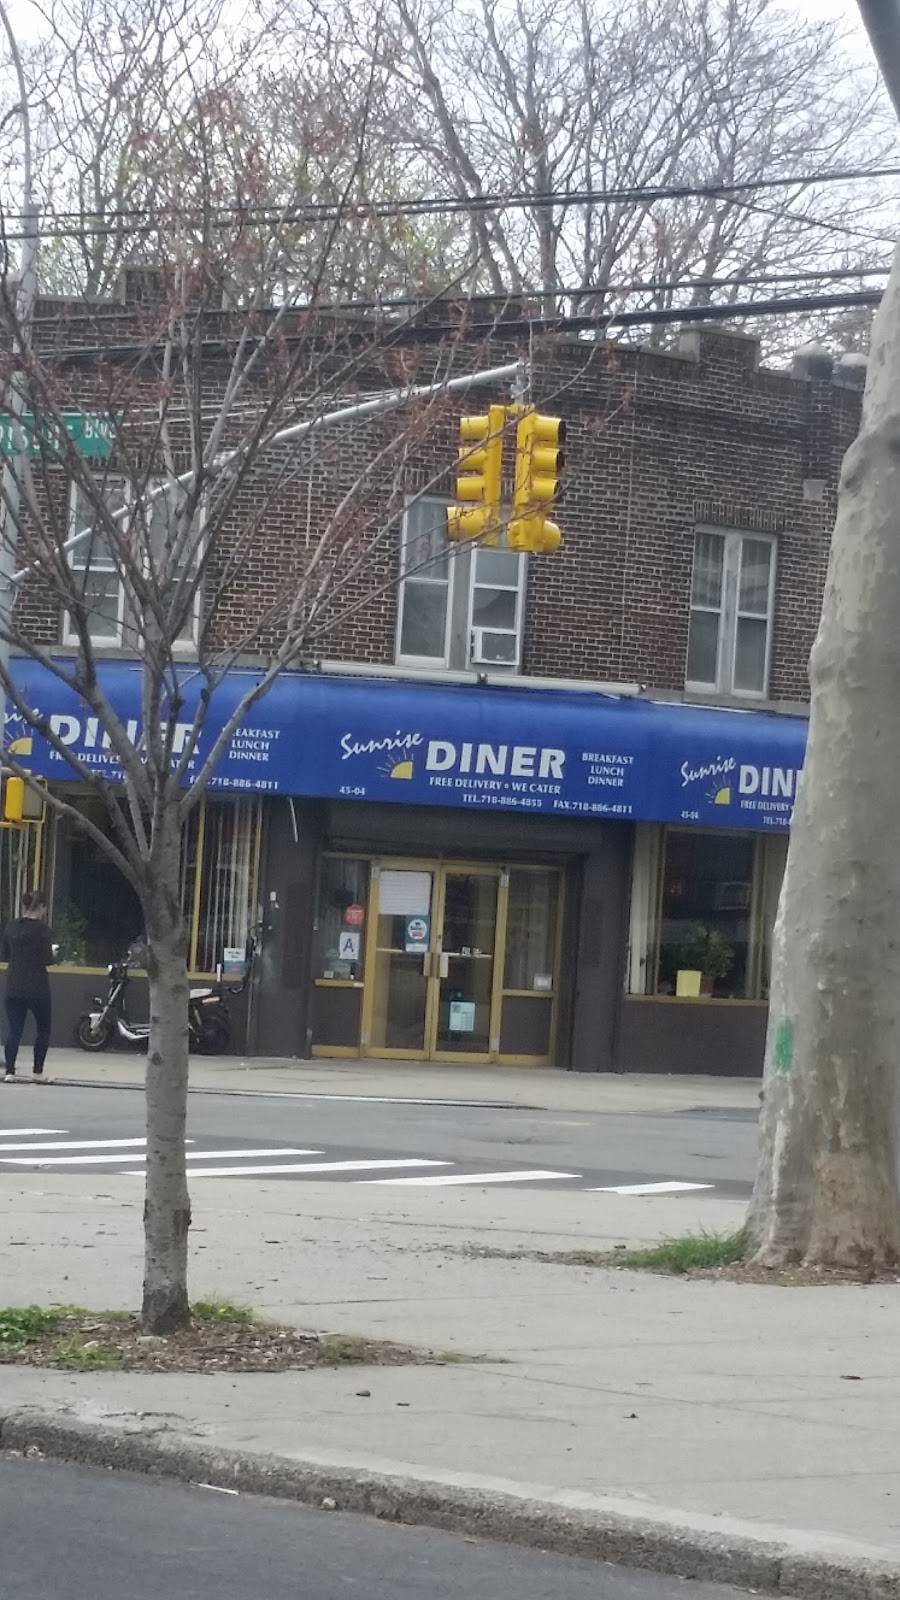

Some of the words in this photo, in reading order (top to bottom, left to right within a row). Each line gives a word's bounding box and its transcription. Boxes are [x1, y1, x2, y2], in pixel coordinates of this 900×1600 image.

[231, 739, 270, 750] LUNCH
[340, 730, 424, 760] Sunrise
[229, 751, 270, 762] DINNER
[425, 740, 566, 779] DINER
[581, 752, 634, 765] BREAKFAST
[590, 765, 625, 777] LUNCH
[680, 755, 737, 787] Sunrise
[429, 776, 454, 788] FREE
[455, 778, 502, 791] DELIVERY
[512, 782, 528, 793] WE
[529, 783, 561, 795] CATER
[587, 776, 624, 787] DINNER
[342, 937, 354, 953] A
